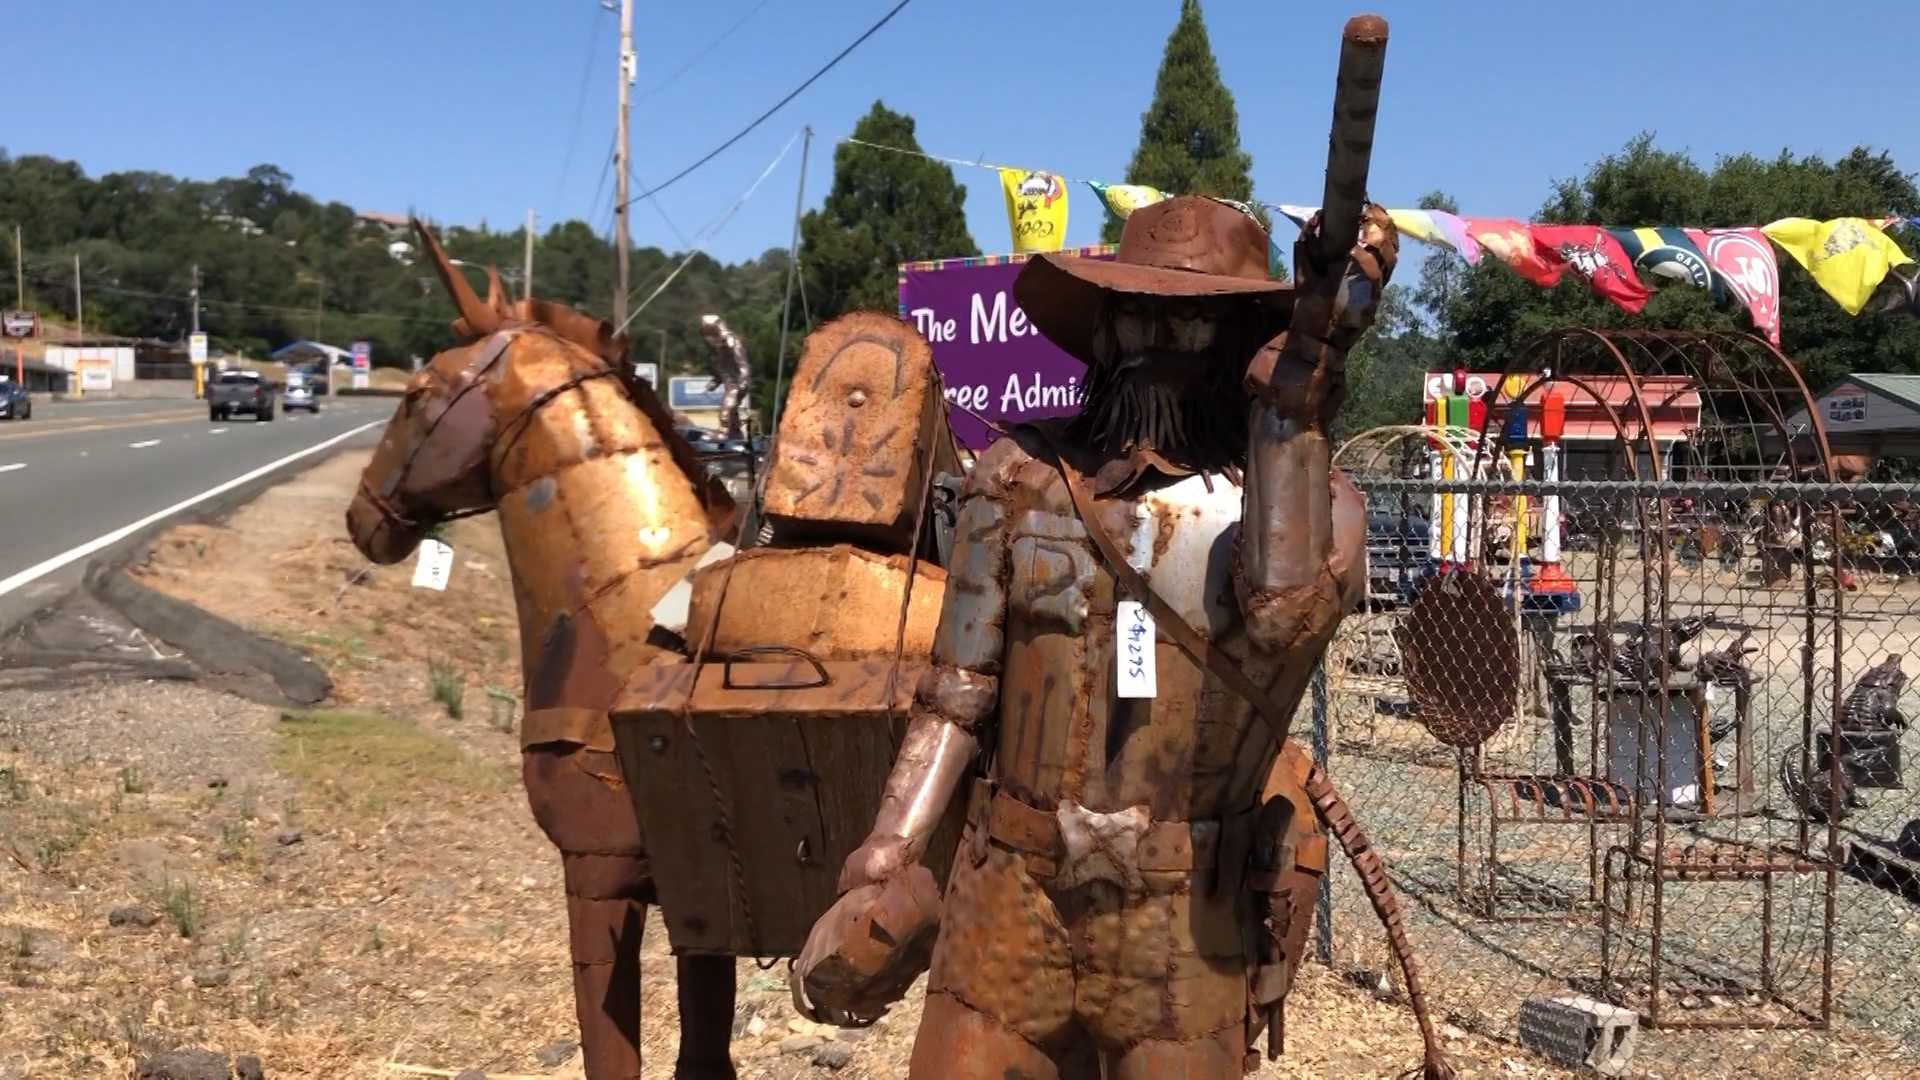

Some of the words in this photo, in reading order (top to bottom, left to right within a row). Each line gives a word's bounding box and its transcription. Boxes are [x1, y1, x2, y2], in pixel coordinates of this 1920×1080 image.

[911, 308, 956, 342] The
[970, 291, 1039, 345] Me
[942, 381, 989, 411] ree
[1001, 371, 1085, 413] Admi
